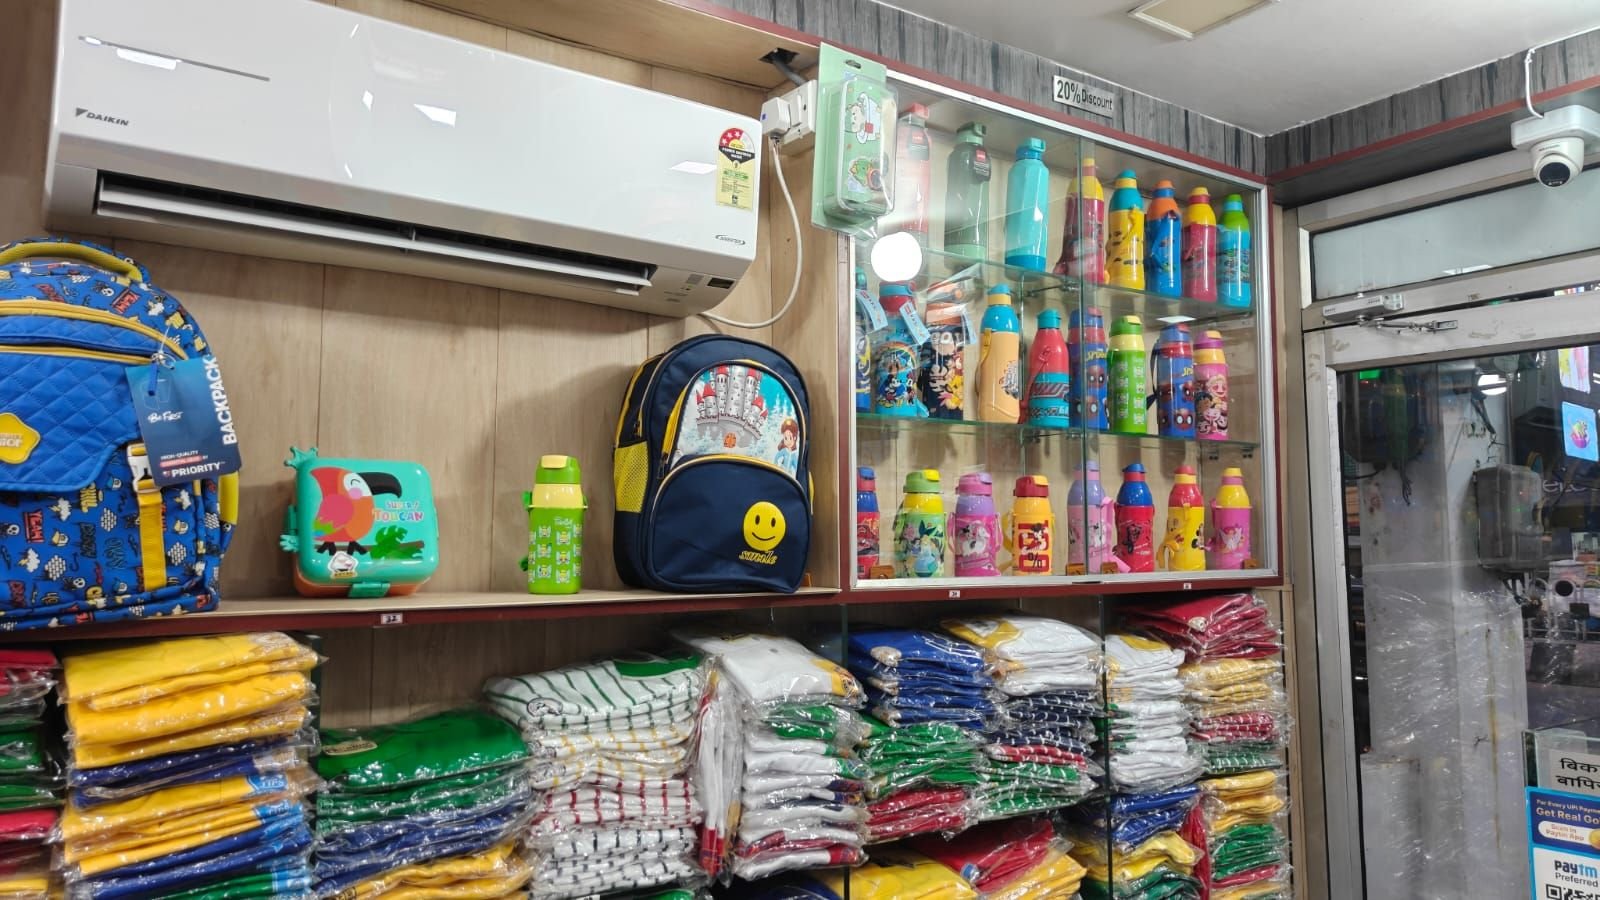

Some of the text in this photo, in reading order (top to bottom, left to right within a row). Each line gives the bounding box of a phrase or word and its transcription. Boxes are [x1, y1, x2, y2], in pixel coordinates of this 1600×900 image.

[1056, 79, 1113, 110] 20% Discount
[86, 112, 129, 126] DAIKIN
[203, 354, 238, 445] BACKPACK
[171, 461, 221, 478] PRIORITY
[1547, 800, 1566, 809] Every
[1536, 807, 1556, 818] Get
[1557, 810, 1582, 822] Real
[1555, 872, 1599, 888] Preferred
